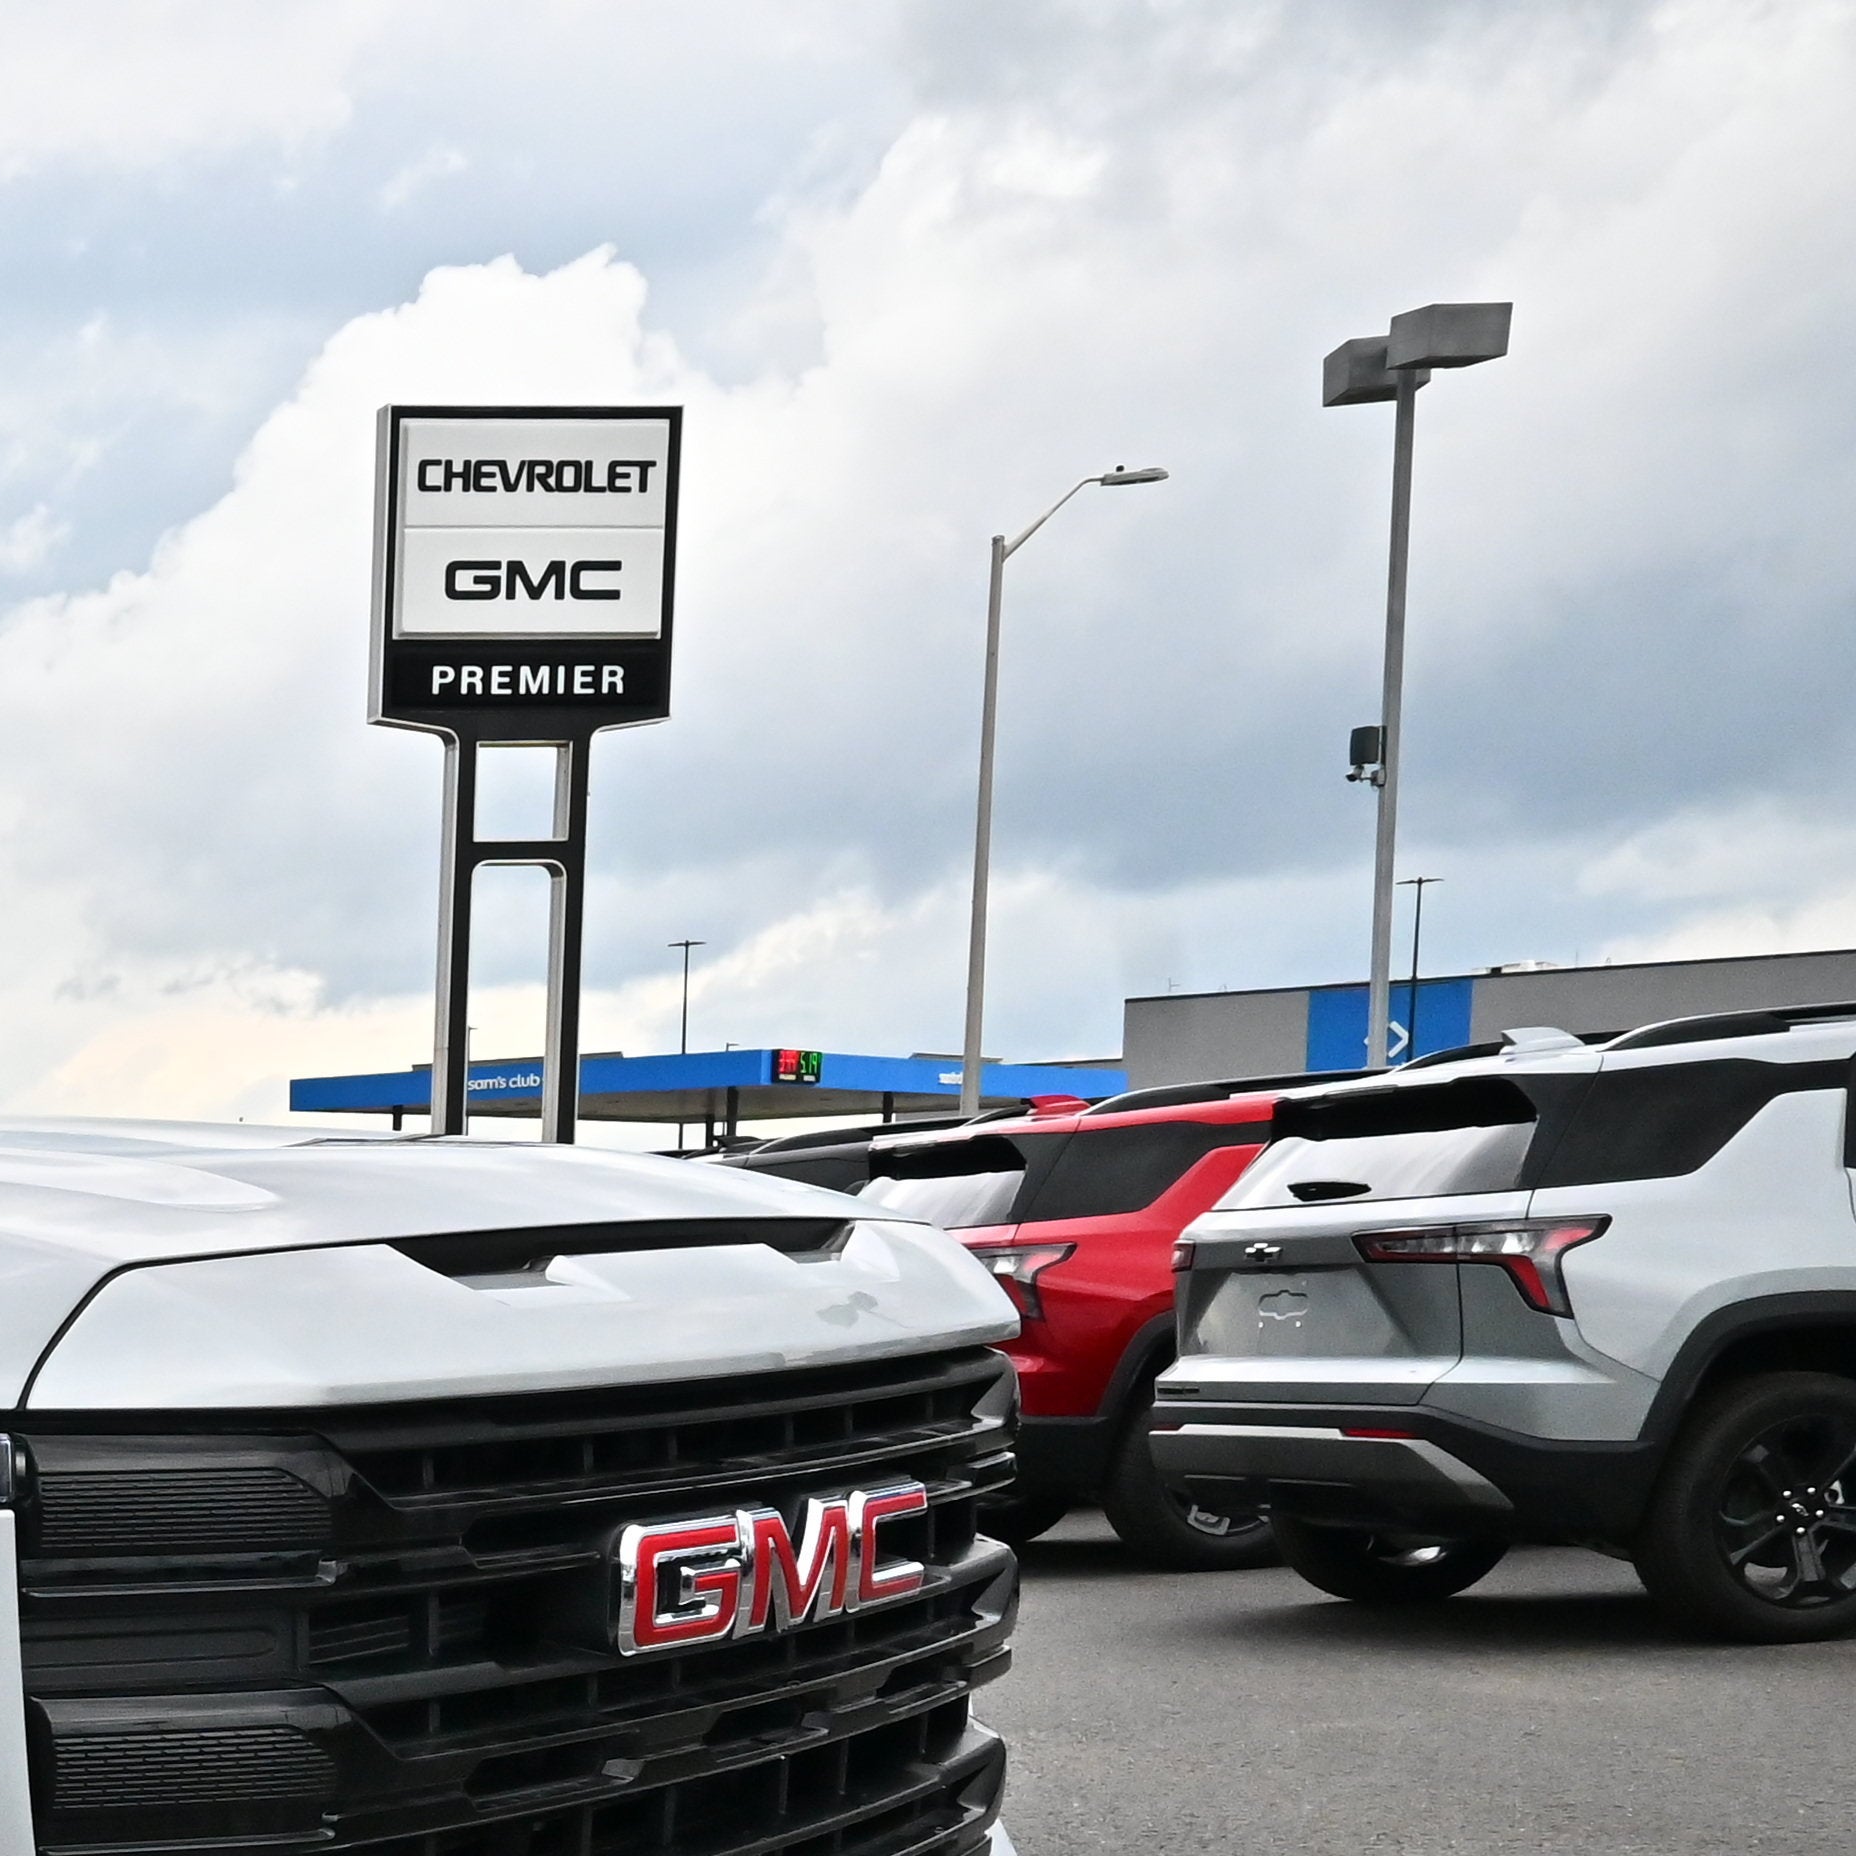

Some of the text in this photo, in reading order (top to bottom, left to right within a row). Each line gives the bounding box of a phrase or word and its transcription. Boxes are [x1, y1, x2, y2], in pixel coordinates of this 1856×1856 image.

[417, 459, 657, 493] CHEVROLET
[444, 560, 623, 601] GMC
[431, 665, 626, 697] PREMIER
[508, 1073, 541, 1089] club
[618, 1478, 929, 1657] GMC
